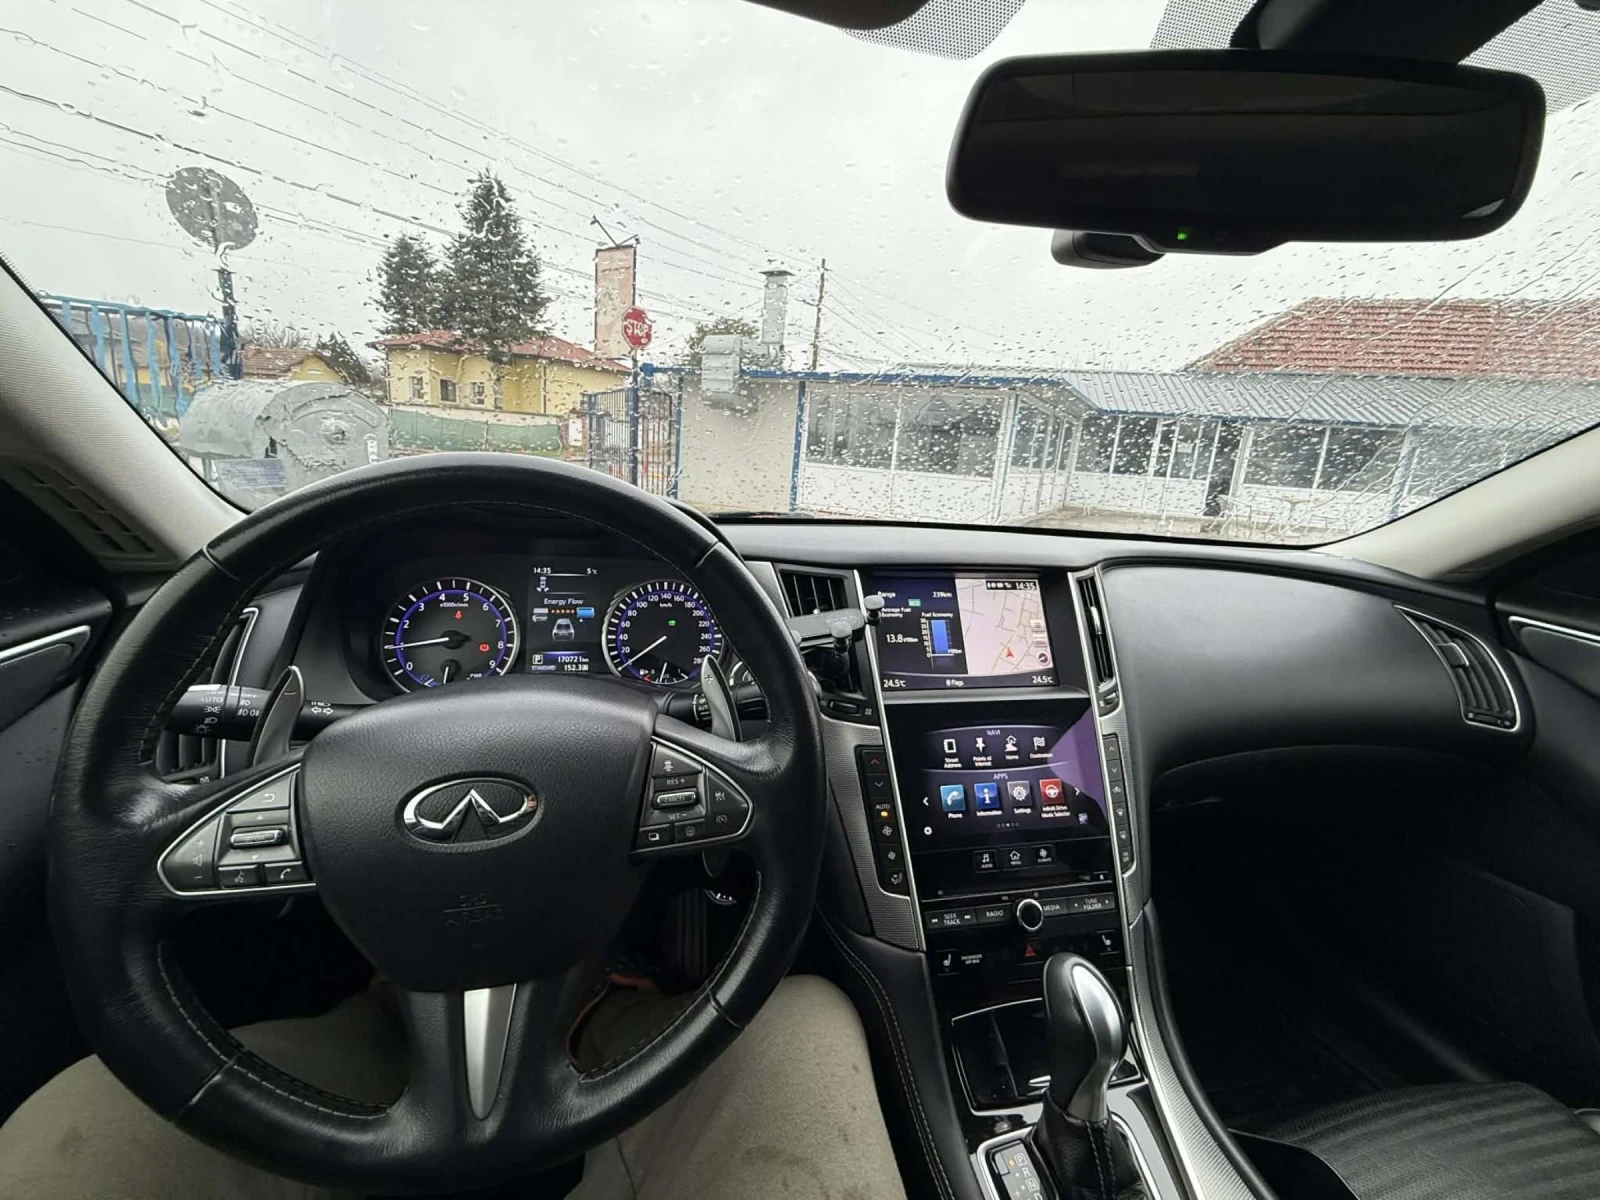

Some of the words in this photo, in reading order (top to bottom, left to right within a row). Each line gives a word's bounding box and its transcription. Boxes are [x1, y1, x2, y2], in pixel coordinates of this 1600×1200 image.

[624, 319, 649, 337] STOP
[1016, 582, 1036, 590] 14:35
[439, 593, 446, 601] 4
[463, 593, 469, 601] 5
[418, 603, 424, 611] 3
[483, 603, 489, 611] 6
[403, 620, 409, 629] 2
[495, 620, 501, 628] 7
[497, 641, 504, 649] 8
[406, 662, 413, 670] 0
[489, 660, 496, 668] 9
[1022, 1167, 1032, 1178] R
